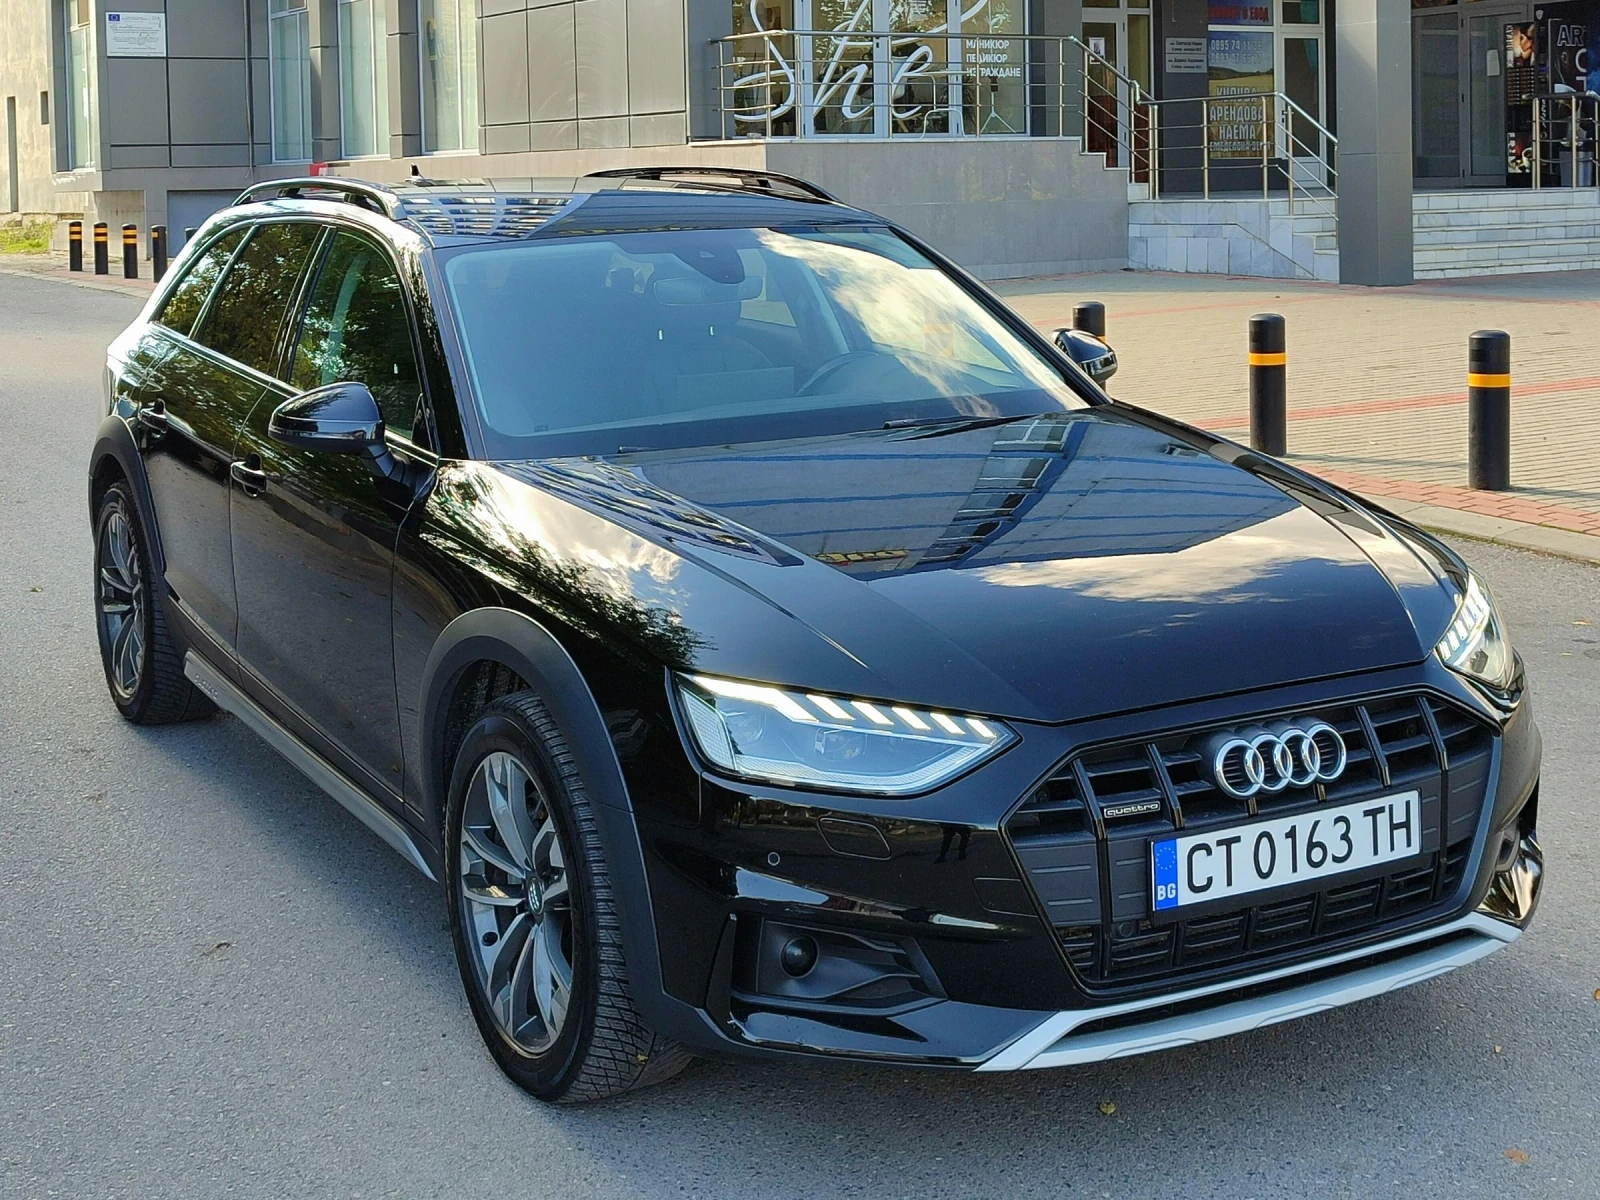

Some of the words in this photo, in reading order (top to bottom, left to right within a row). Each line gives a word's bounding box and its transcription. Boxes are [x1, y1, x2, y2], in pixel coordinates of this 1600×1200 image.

[966, 39, 1010, 49] МАНИКЮР
[1210, 39, 1229, 51] 0895
[1231, 39, 1241, 51] 74
[966, 53, 1008, 63] ПЕДИКЮР
[1210, 105, 1264, 123] АРЕНДОВА
[1219, 124, 1256, 140] НАЕМА
[1106, 803, 1159, 817] quattro
[1187, 835, 1242, 894] CT
[1253, 815, 1353, 881] 0163
[1363, 799, 1413, 857] TH
[1157, 882, 1177, 901] BG
